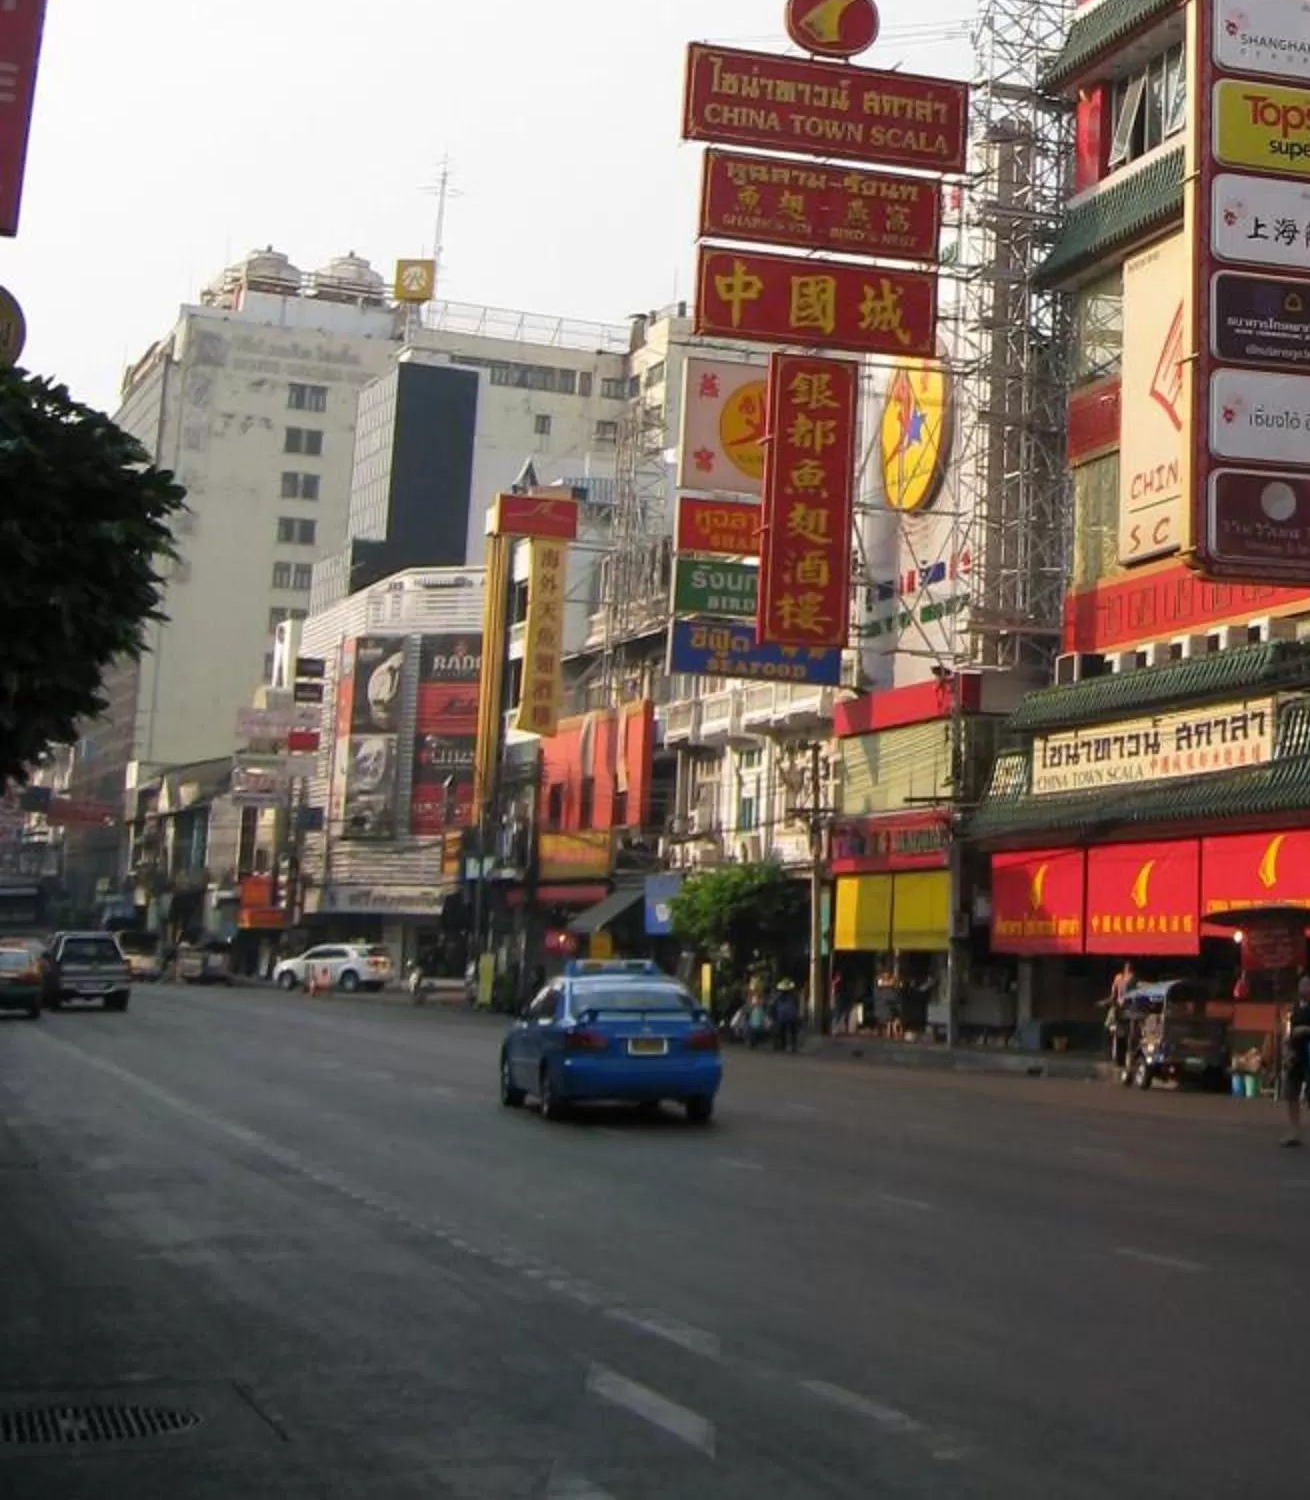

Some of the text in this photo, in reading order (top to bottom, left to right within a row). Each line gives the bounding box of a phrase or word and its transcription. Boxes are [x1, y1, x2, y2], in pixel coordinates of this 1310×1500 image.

[702, 102, 948, 155] CHINA TOWN SCALA
[714, 259, 912, 345] 中國城
[1131, 458, 1182, 501] CHIN
[1036, 762, 1145, 791] CHINA TOWN SCALA
